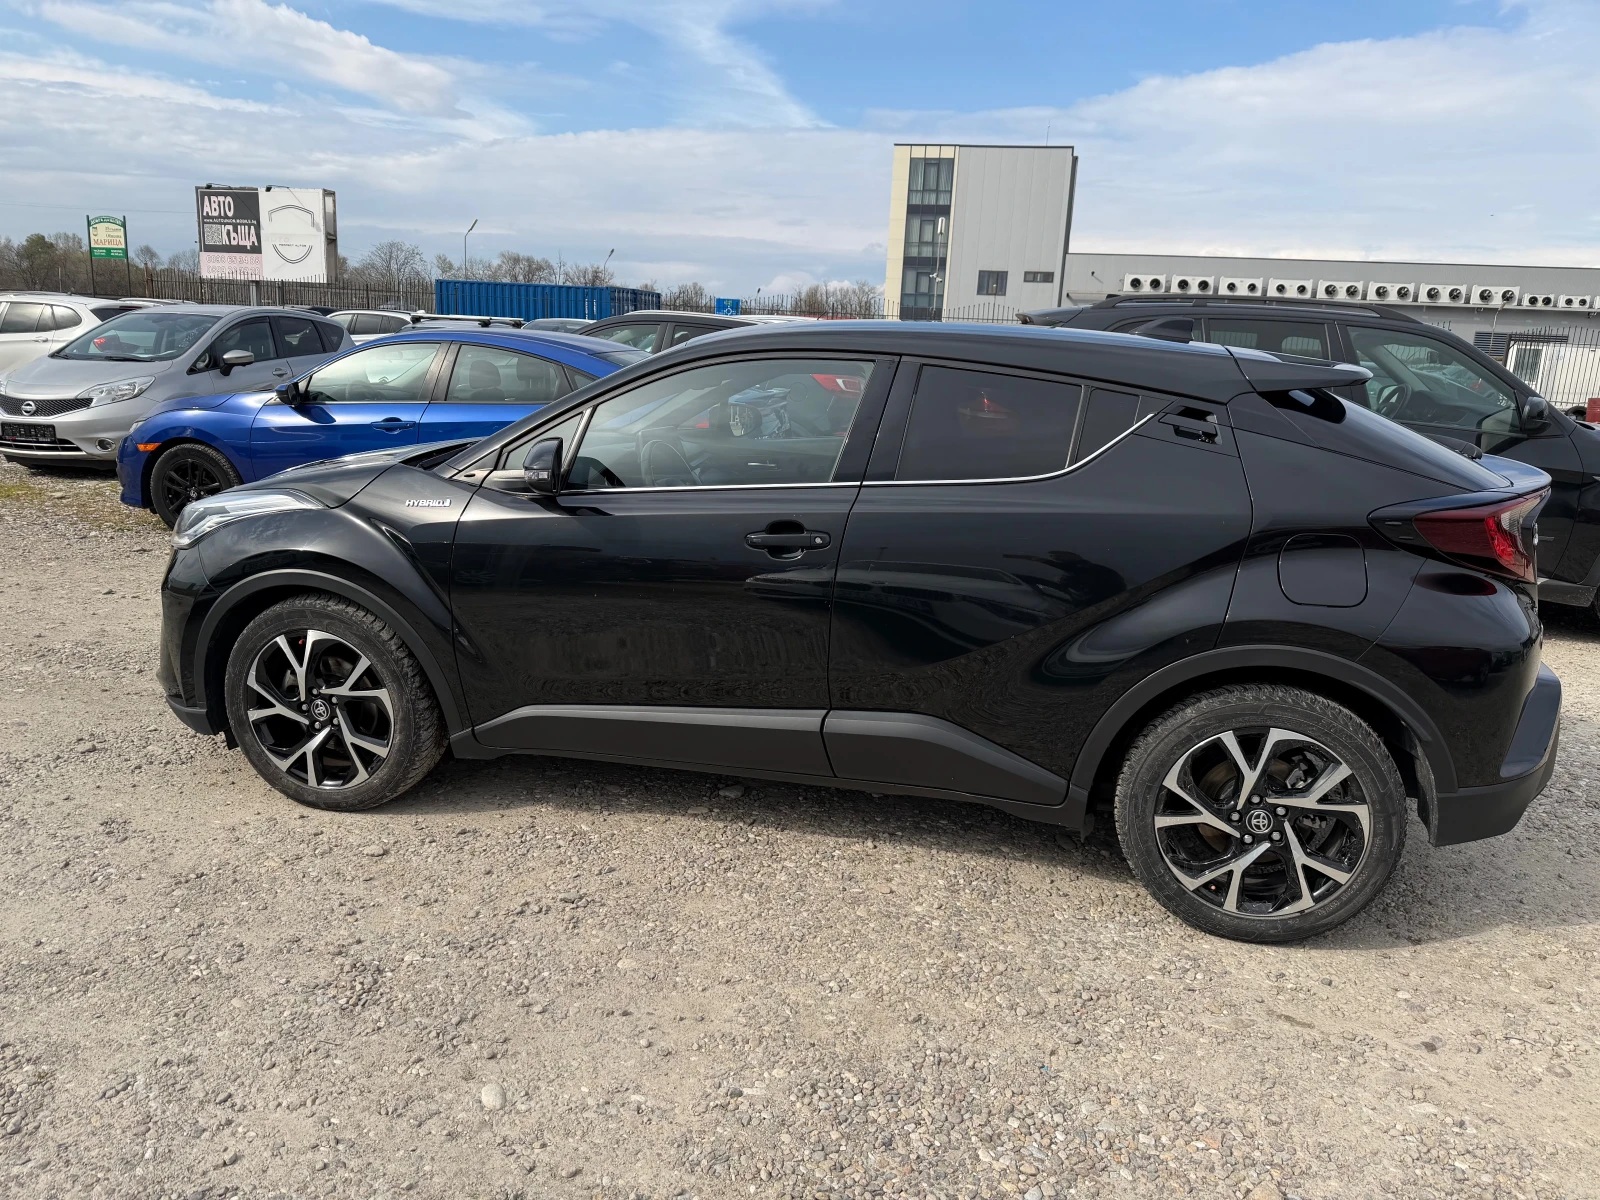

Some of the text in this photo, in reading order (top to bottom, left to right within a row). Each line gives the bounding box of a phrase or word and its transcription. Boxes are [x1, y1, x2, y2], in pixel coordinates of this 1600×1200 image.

[203, 195, 234, 217] АВТО
[93, 238, 123, 246] МАРИЦА
[222, 225, 258, 250] КЪЩА
[405, 499, 444, 507] HYBRID
